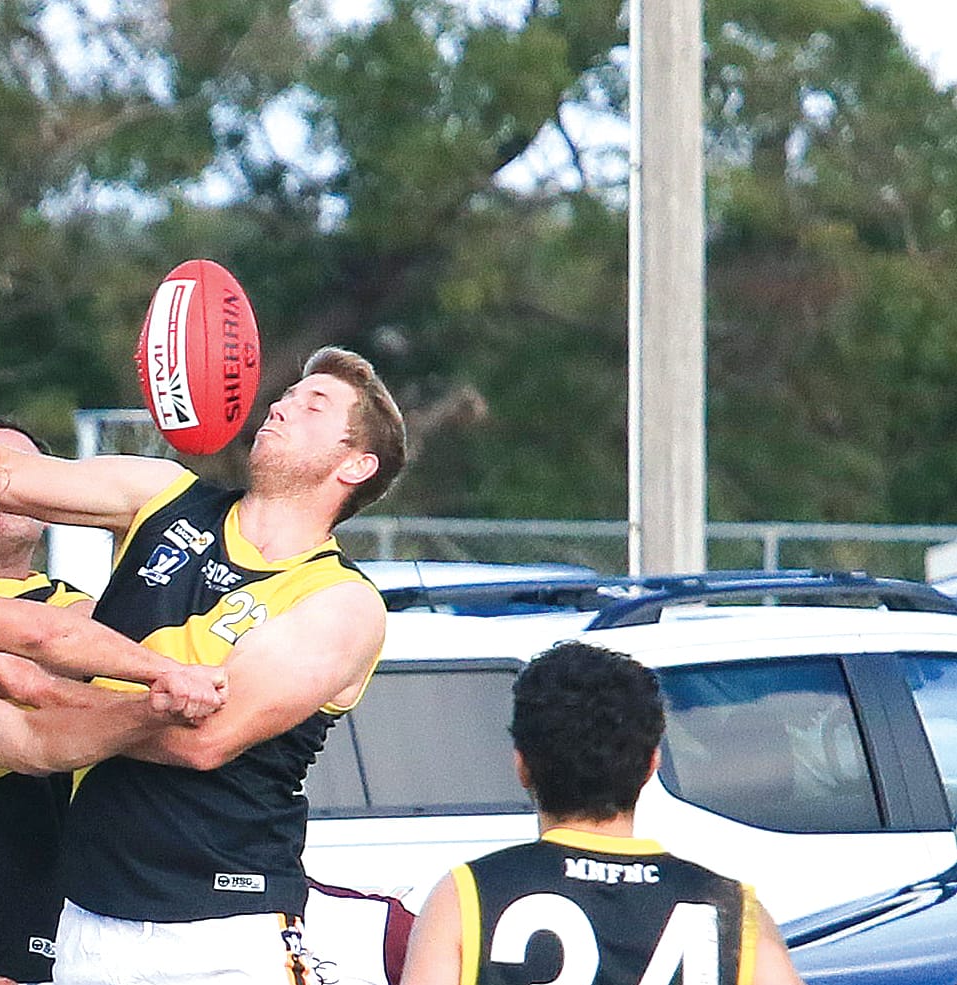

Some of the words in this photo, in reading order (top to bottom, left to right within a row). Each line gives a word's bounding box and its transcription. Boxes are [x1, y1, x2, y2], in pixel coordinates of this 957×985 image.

[154, 345, 173, 425] TTMI
[223, 288, 241, 423] SHERRIN
[563, 857, 661, 885] MNFNC
